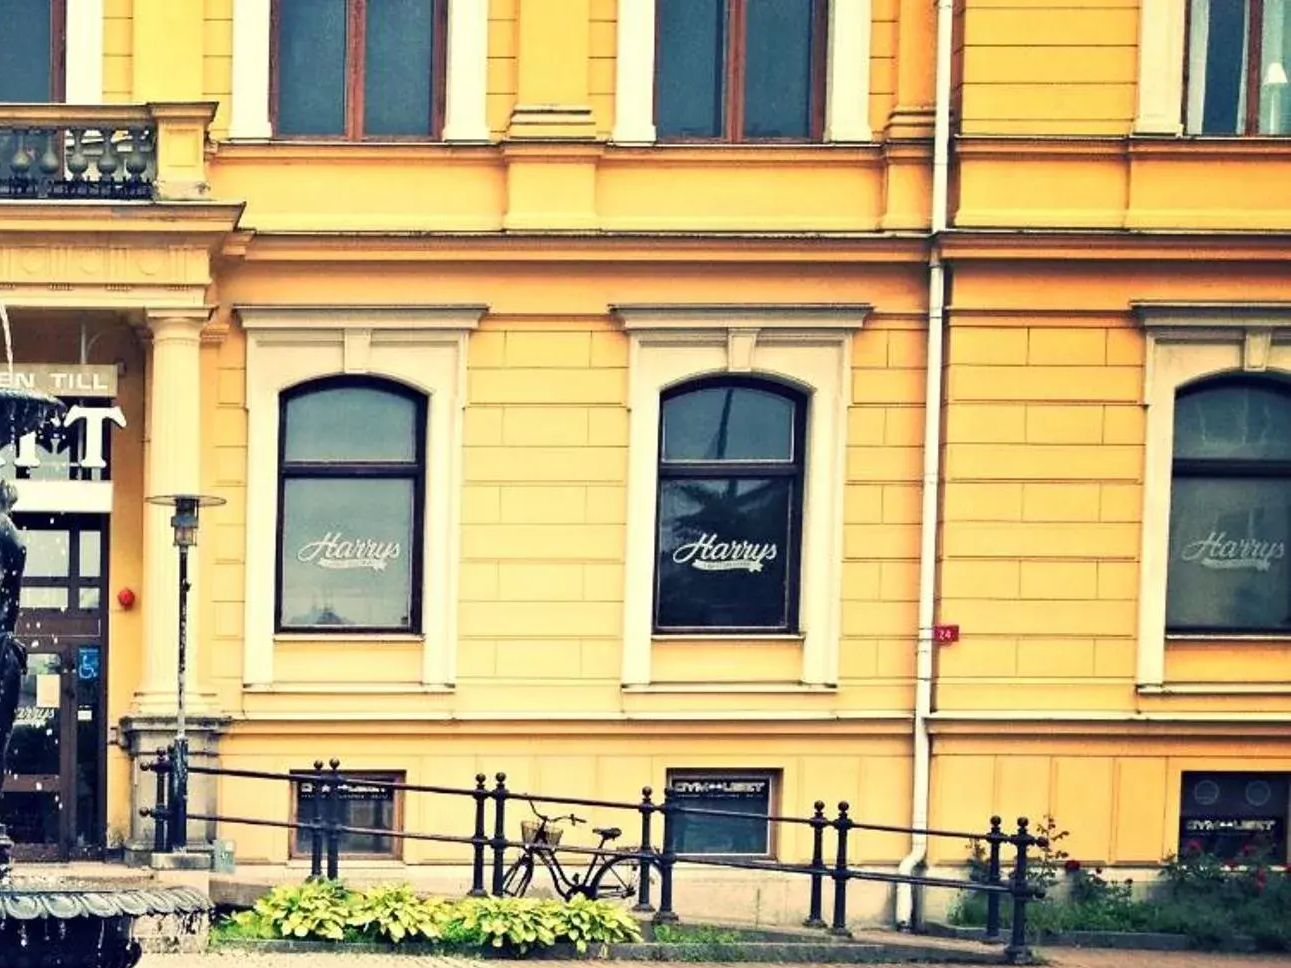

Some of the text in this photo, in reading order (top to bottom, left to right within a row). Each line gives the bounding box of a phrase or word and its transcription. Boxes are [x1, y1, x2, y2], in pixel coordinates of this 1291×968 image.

[50, 372, 108, 390] TILL
[297, 531, 400, 562] Harrys
[672, 532, 778, 563] Harrys
[1181, 531, 1285, 561] Harrys
